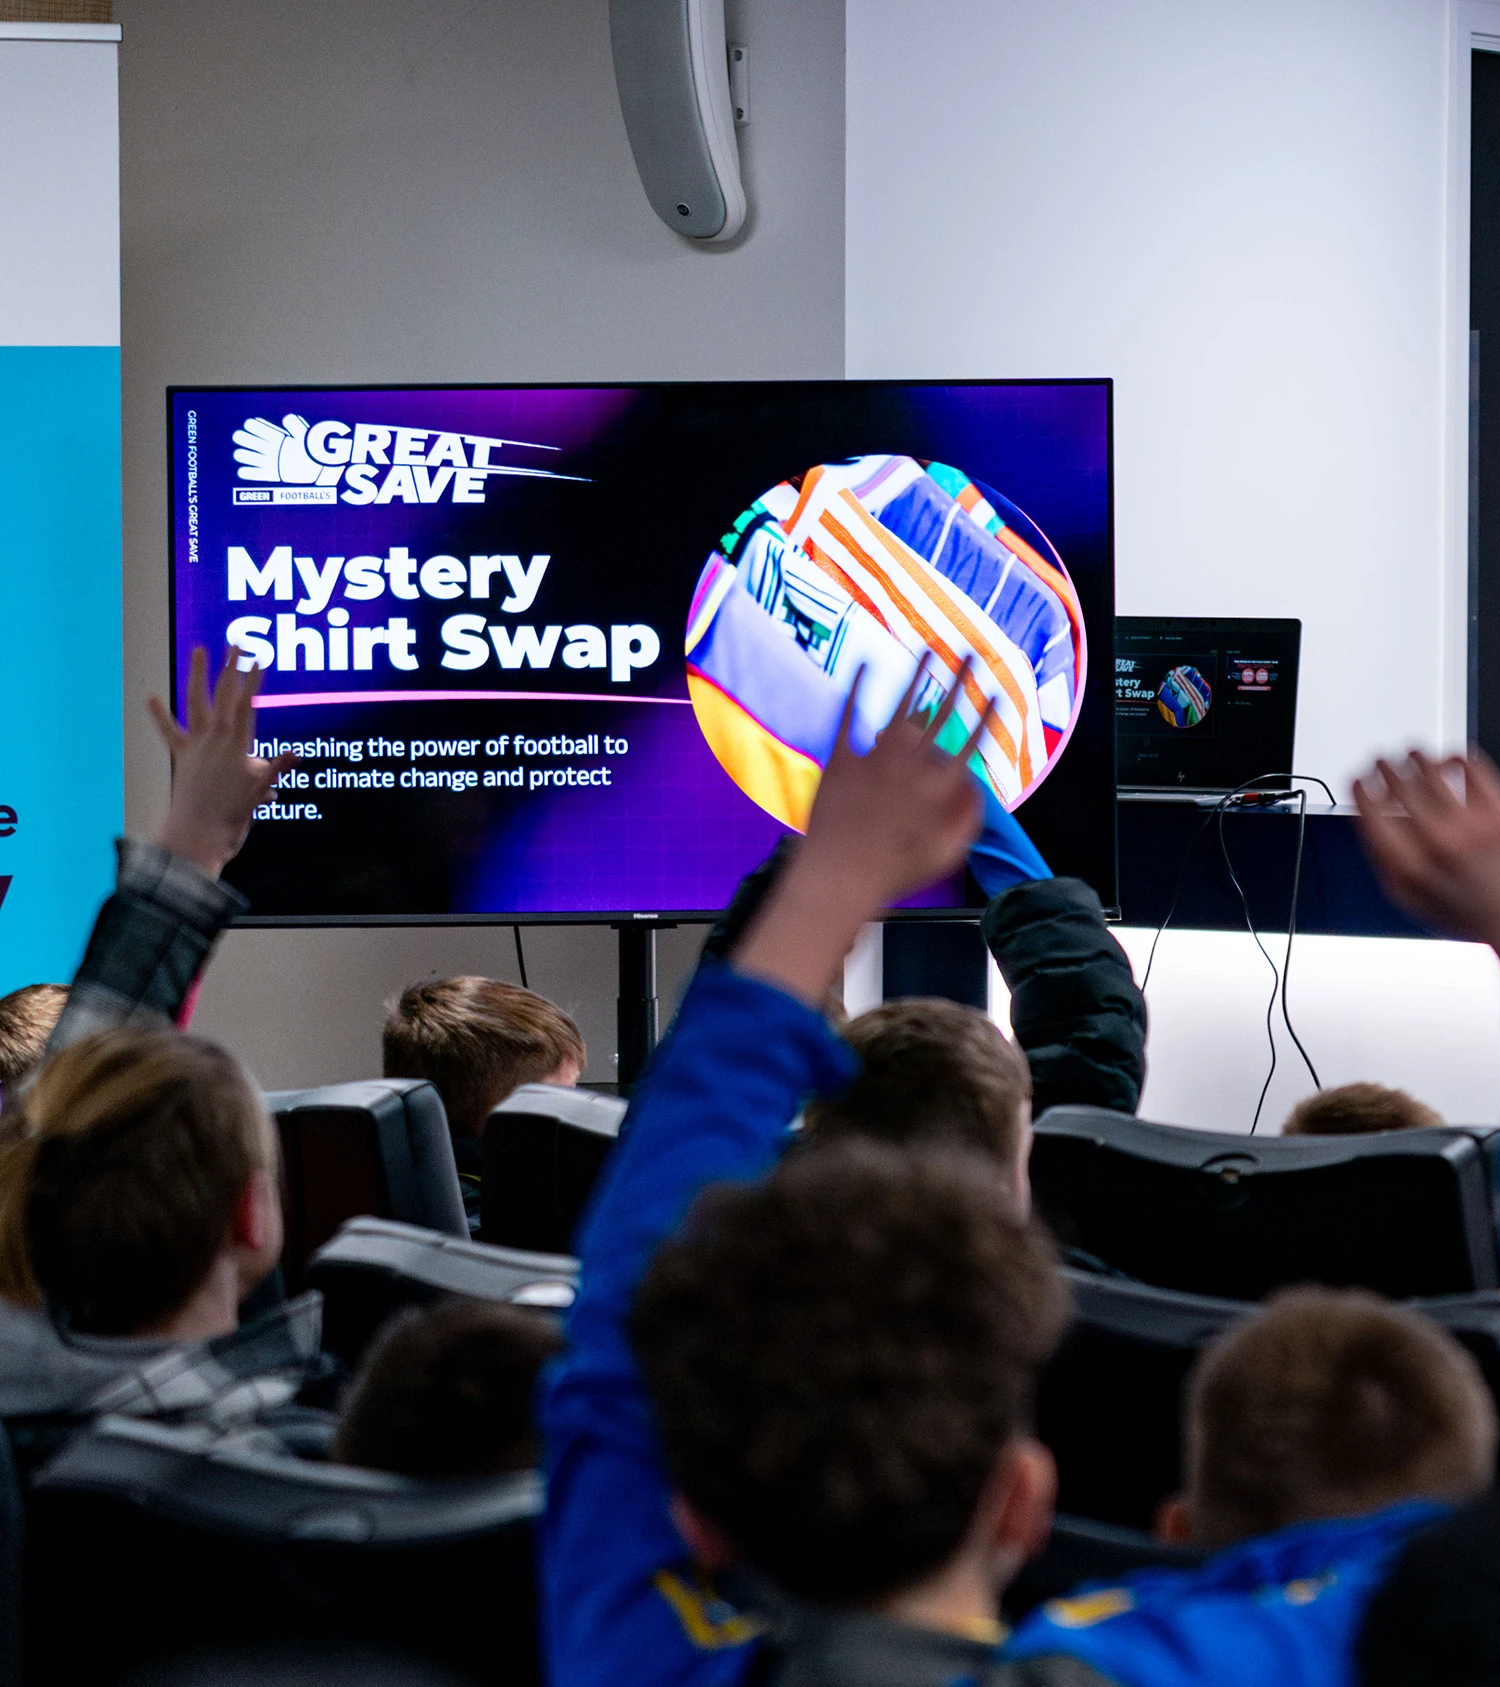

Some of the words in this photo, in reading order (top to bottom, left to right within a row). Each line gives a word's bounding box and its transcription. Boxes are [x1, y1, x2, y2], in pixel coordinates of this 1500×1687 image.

[187, 410, 197, 444] GREEN
[306, 420, 502, 468] GREAT
[188, 445, 198, 503] FOOTBALL'S
[341, 463, 488, 505] SAVE
[239, 491, 270, 501] GREEN
[280, 492, 331, 500] FOOTBALL'S
[188, 504, 199, 537] GREAT
[189, 537, 199, 563] SAVE
[227, 546, 551, 615] Mystery
[225, 608, 419, 672] Shirt
[441, 613, 661, 682] Swap
[1116, 678, 1141, 689] stery
[1125, 688, 1155, 701] Swap
[246, 737, 363, 762] Unleashing
[367, 736, 406, 757] the
[410, 740, 480, 762] power
[484, 735, 509, 756] of
[513, 735, 599, 756] football
[604, 737, 629, 754] to
[270, 768, 310, 789] kle
[314, 768, 395, 789] climate
[399, 768, 478, 793] change
[482, 767, 524, 787] and
[529, 768, 611, 791] protect
